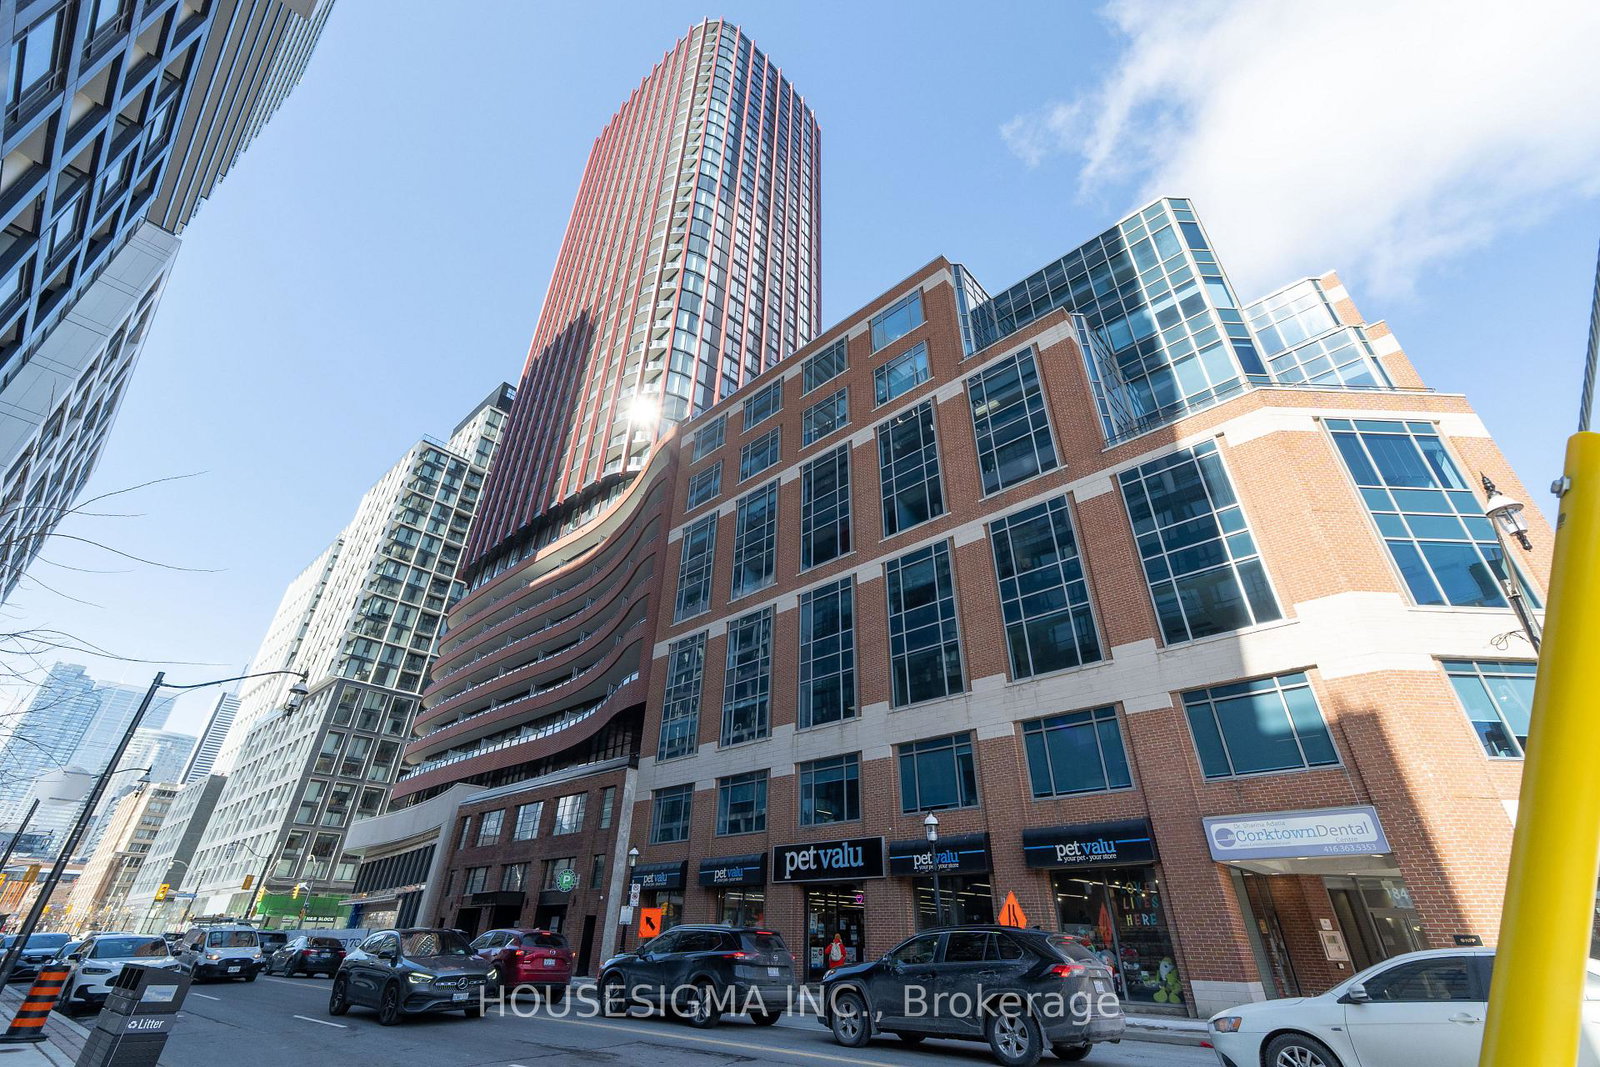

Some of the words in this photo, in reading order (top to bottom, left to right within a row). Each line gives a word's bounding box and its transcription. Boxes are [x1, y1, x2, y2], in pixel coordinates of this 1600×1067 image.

[1055, 841, 1081, 861] pet
[1081, 839, 1117, 855] valu
[785, 845, 817, 880] pet
[818, 842, 864, 869] valu
[913, 852, 933, 870] pet
[1063, 855, 1076, 863] your
[1076, 854, 1086, 862] pet
[1088, 854, 1102, 862] your
[643, 873, 654, 886] pet
[654, 872, 668, 882] valu
[714, 868, 727, 882] pet
[727, 866, 744, 878] valu
[1126, 913, 1157, 926] HERE
[138, 1018, 164, 1029] Litter
